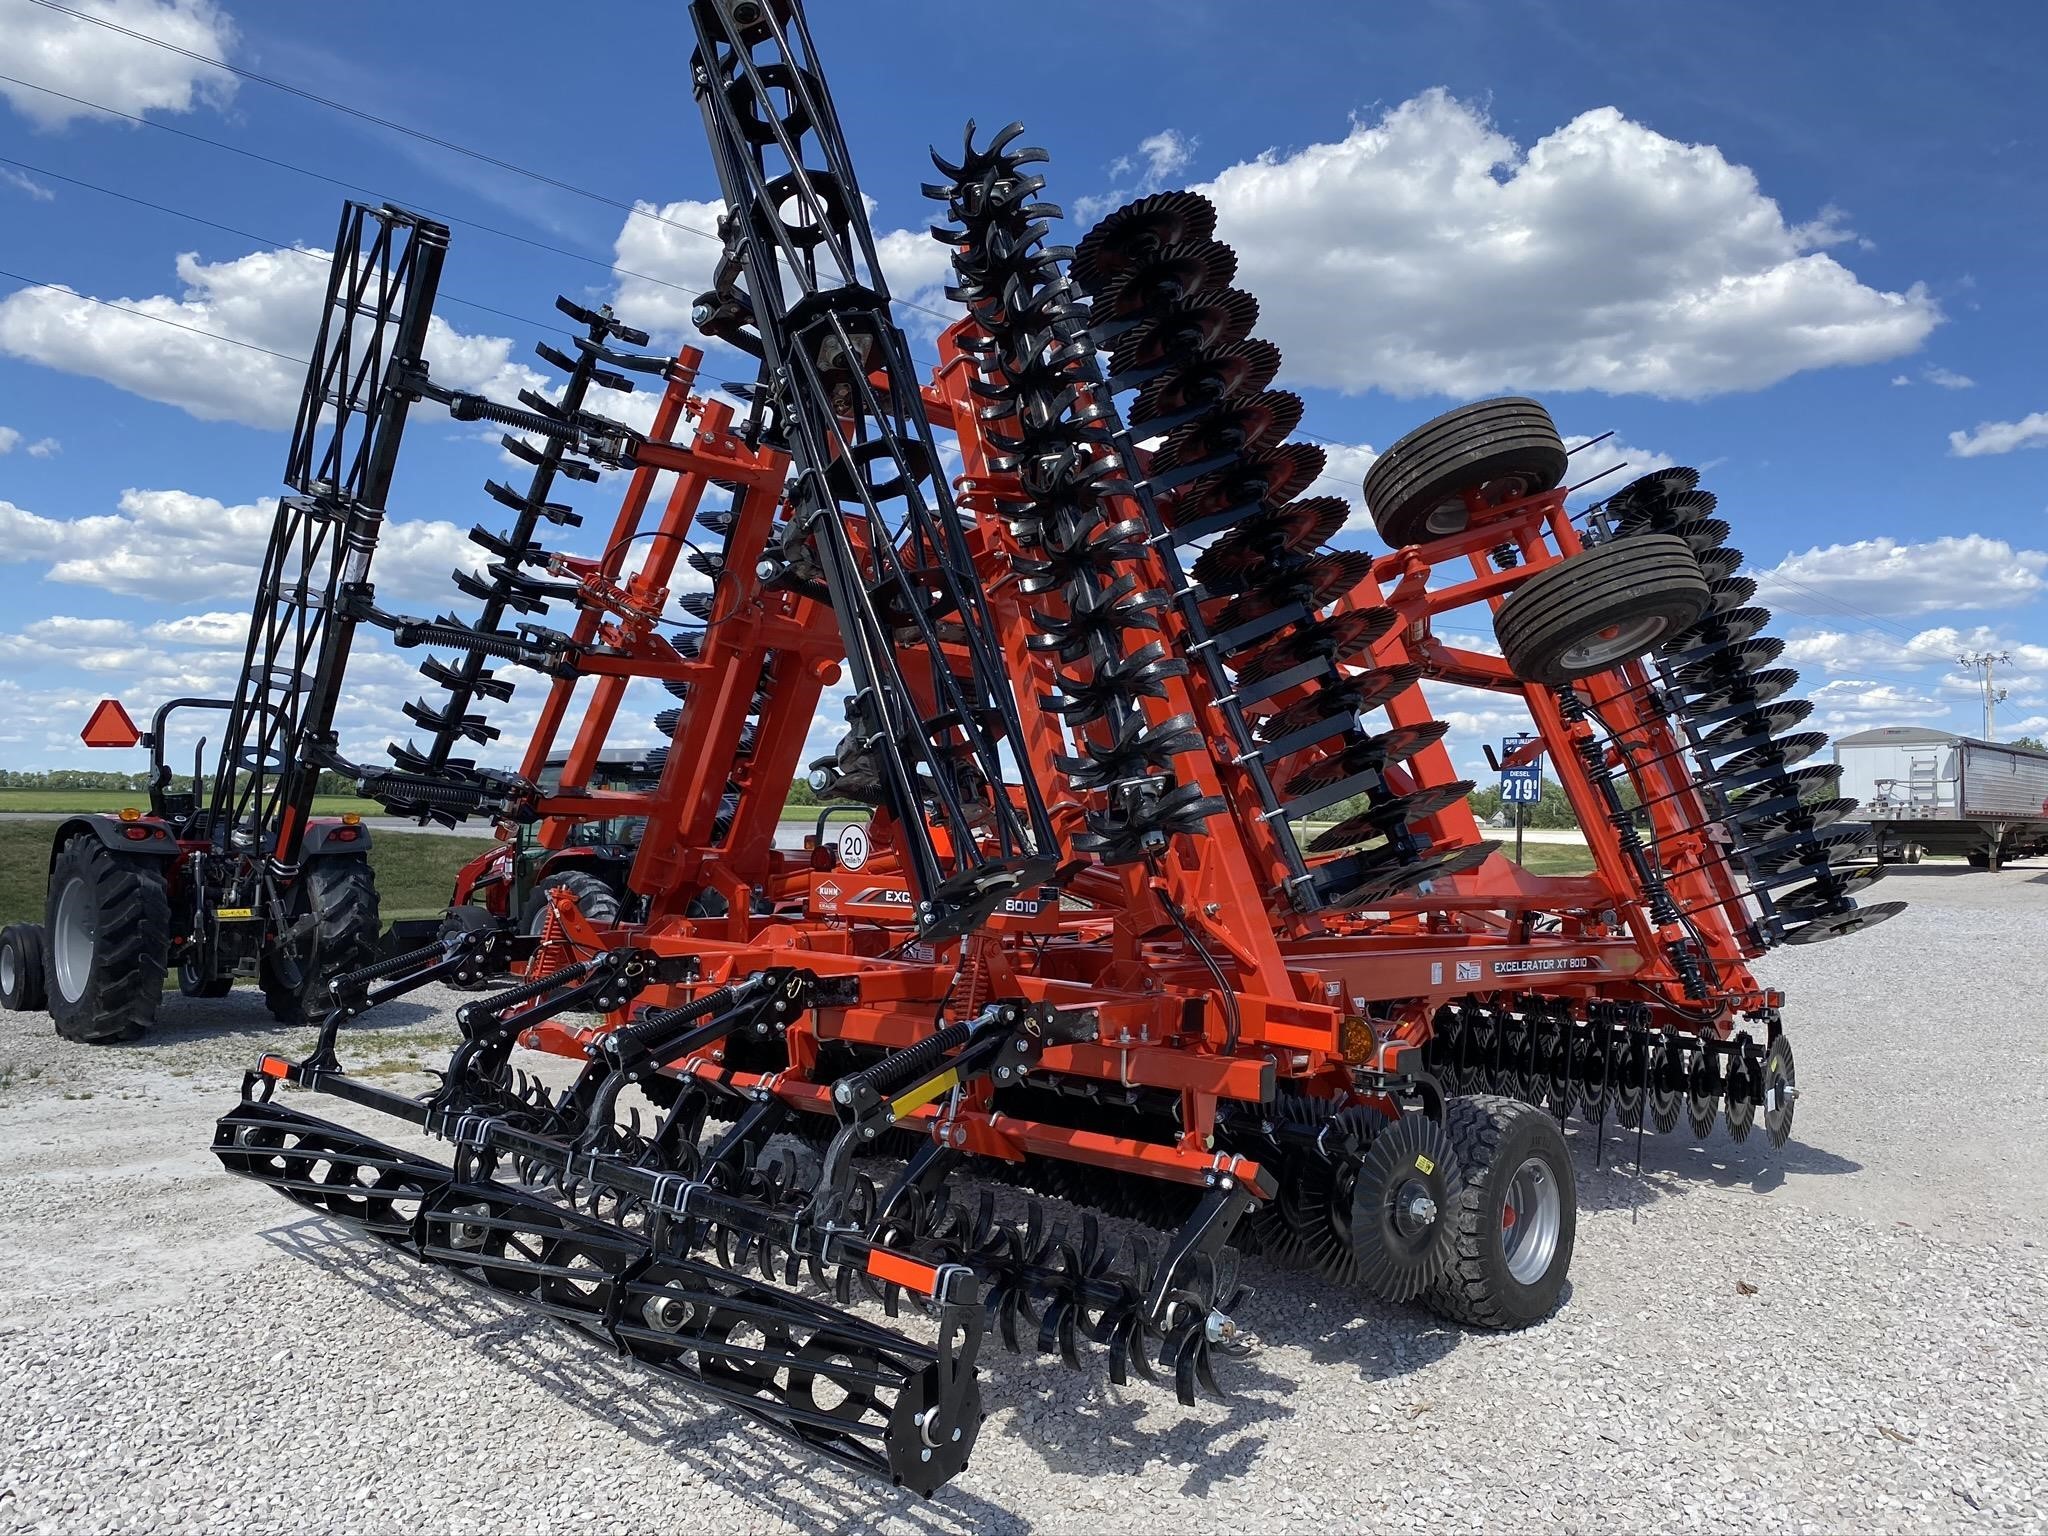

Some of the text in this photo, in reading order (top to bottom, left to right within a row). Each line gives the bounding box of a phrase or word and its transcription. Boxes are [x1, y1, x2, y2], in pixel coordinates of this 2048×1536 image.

[845, 837, 862, 856] 20
[820, 887, 838, 896] KUHN
[885, 890, 1038, 913] EXC 8010
[1494, 959, 1554, 973] EXCELERATOR
[1557, 958, 1567, 969] XT
[1569, 958, 1588, 968] 8010
